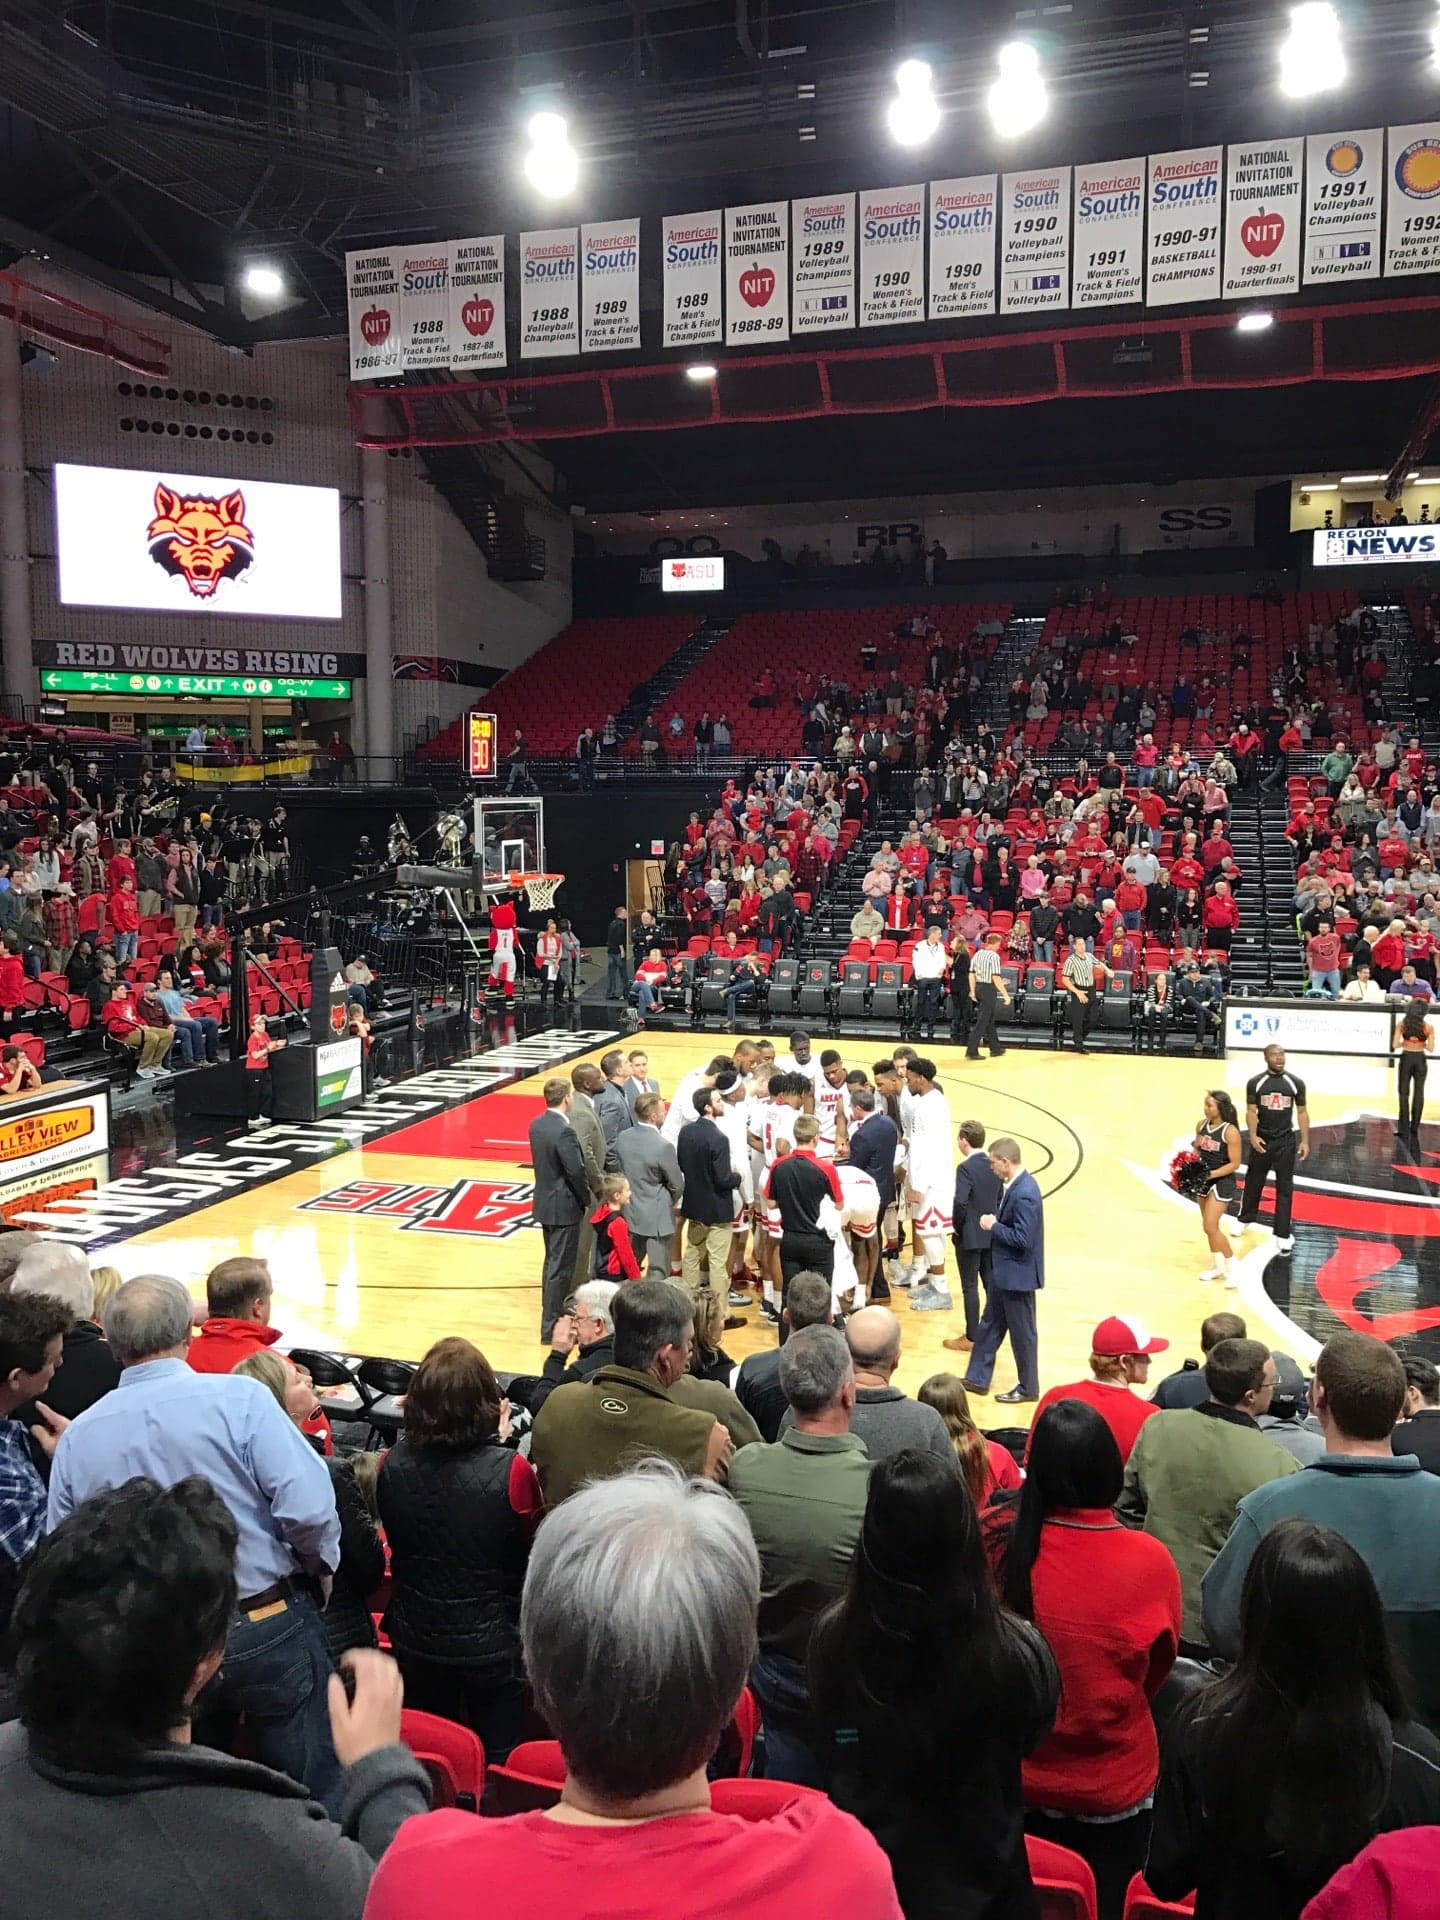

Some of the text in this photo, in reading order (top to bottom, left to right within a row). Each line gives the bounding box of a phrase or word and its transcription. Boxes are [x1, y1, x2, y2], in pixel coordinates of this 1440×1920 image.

[1239, 150, 1290, 167] NATIONAL
[1153, 159, 1218, 178] American
[1235, 166, 1293, 183] INVITATION
[1015, 177, 1059, 191] American
[1080, 175, 1140, 193] American
[1152, 176, 1218, 204] South
[1229, 182, 1300, 201] TOURNAMENT
[1320, 180, 1367, 198] 1991
[935, 191, 993, 207] American
[1013, 190, 1059, 209] South
[1079, 191, 1140, 217] South
[1152, 197, 1216, 212] CONFERENCE
[1313, 197, 1374, 212] Volleyball
[804, 203, 845, 216] American
[865, 202, 920, 217] American
[736, 212, 777, 227] NATIONAL
[803, 215, 845, 233] South
[934, 207, 993, 230] South
[1013, 216, 1057, 234] 1990
[1079, 211, 1139, 224] CONFERENCE
[1309, 211, 1377, 226] Champions
[667, 227, 718, 242] American
[733, 226, 780, 242] INVITATION
[864, 217, 920, 239] South
[935, 227, 991, 238] CONFERENCE
[1247, 223, 1281, 243] NIT
[586, 235, 636, 249] American
[865, 236, 920, 246] CONFERENCE
[1008, 236, 1062, 250] Volleyball
[1153, 226, 1218, 247] 1990-91
[457, 246, 494, 259] NATIONAL
[525, 244, 575, 258] American
[666, 241, 718, 263] South
[728, 240, 786, 257] TOURNAMENT
[804, 240, 844, 257] 1989
[1004, 249, 1065, 263] Champions
[1388, 249, 1417, 259] Track
[1421, 247, 1429, 256] &
[356, 256, 391, 269] NATIONAL
[585, 249, 636, 270] South
[799, 255, 849, 268] Volleyball
[1088, 249, 1126, 266] 1991
[1151, 249, 1216, 265] BASKETBALL
[455, 259, 498, 273] INVITATION
[524, 257, 575, 278] South
[945, 263, 982, 279] 1990
[1087, 267, 1129, 279] Women's
[1240, 263, 1282, 276] 1990-91
[1310, 260, 1372, 275] Volleyball
[354, 269, 394, 284] INVITATION
[451, 272, 503, 287] TOURNAMENT
[796, 268, 851, 281] Champions
[874, 271, 910, 287] 1990
[1151, 267, 1215, 283] CHAMPIONS
[1226, 274, 1295, 290] Quarterfinals
[350, 283, 399, 297] TOURNAMENT
[744, 277, 772, 295] NIT
[949, 280, 976, 290] Men's
[1076, 277, 1140, 292] Track & Field
[676, 293, 709, 309] 1989
[873, 288, 912, 299] Women's
[932, 290, 993, 303] Track & Field
[1007, 293, 1061, 306] Volleyball
[1080, 288, 1134, 302] Champions
[595, 300, 627, 314] 1989
[863, 298, 922, 311] Track & Field
[937, 301, 988, 313] Champions
[466, 308, 491, 323] NIT
[531, 307, 569, 322] 1988
[593, 316, 629, 326] Women's
[680, 311, 705, 320] Men's
[798, 313, 848, 326] Volleyball
[867, 309, 917, 321] Champions
[365, 318, 389, 333] NIT
[413, 320, 443, 334] 1988
[527, 322, 574, 333] Volleyball
[585, 325, 639, 337] Track & Field
[667, 318, 720, 332] Track & Field
[731, 317, 783, 333] 1988-89
[524, 333, 576, 343] Champions
[589, 336, 634, 347] Champions
[670, 330, 716, 342] Champions
[403, 346, 424, 355] Track
[434, 344, 450, 353] Fiel
[452, 352, 504, 363] Quarterfinals
[1159, 506, 1232, 532] SS
[857, 523, 919, 546] RR
[1327, 529, 1386, 539] REGION
[1346, 535, 1434, 556] NEWS
[687, 565, 714, 579] ASU
[56, 642, 338, 675] RED WOLVES RISING
[178, 677, 226, 692] EXIT
[40, 1119, 79, 1140] VIEW
